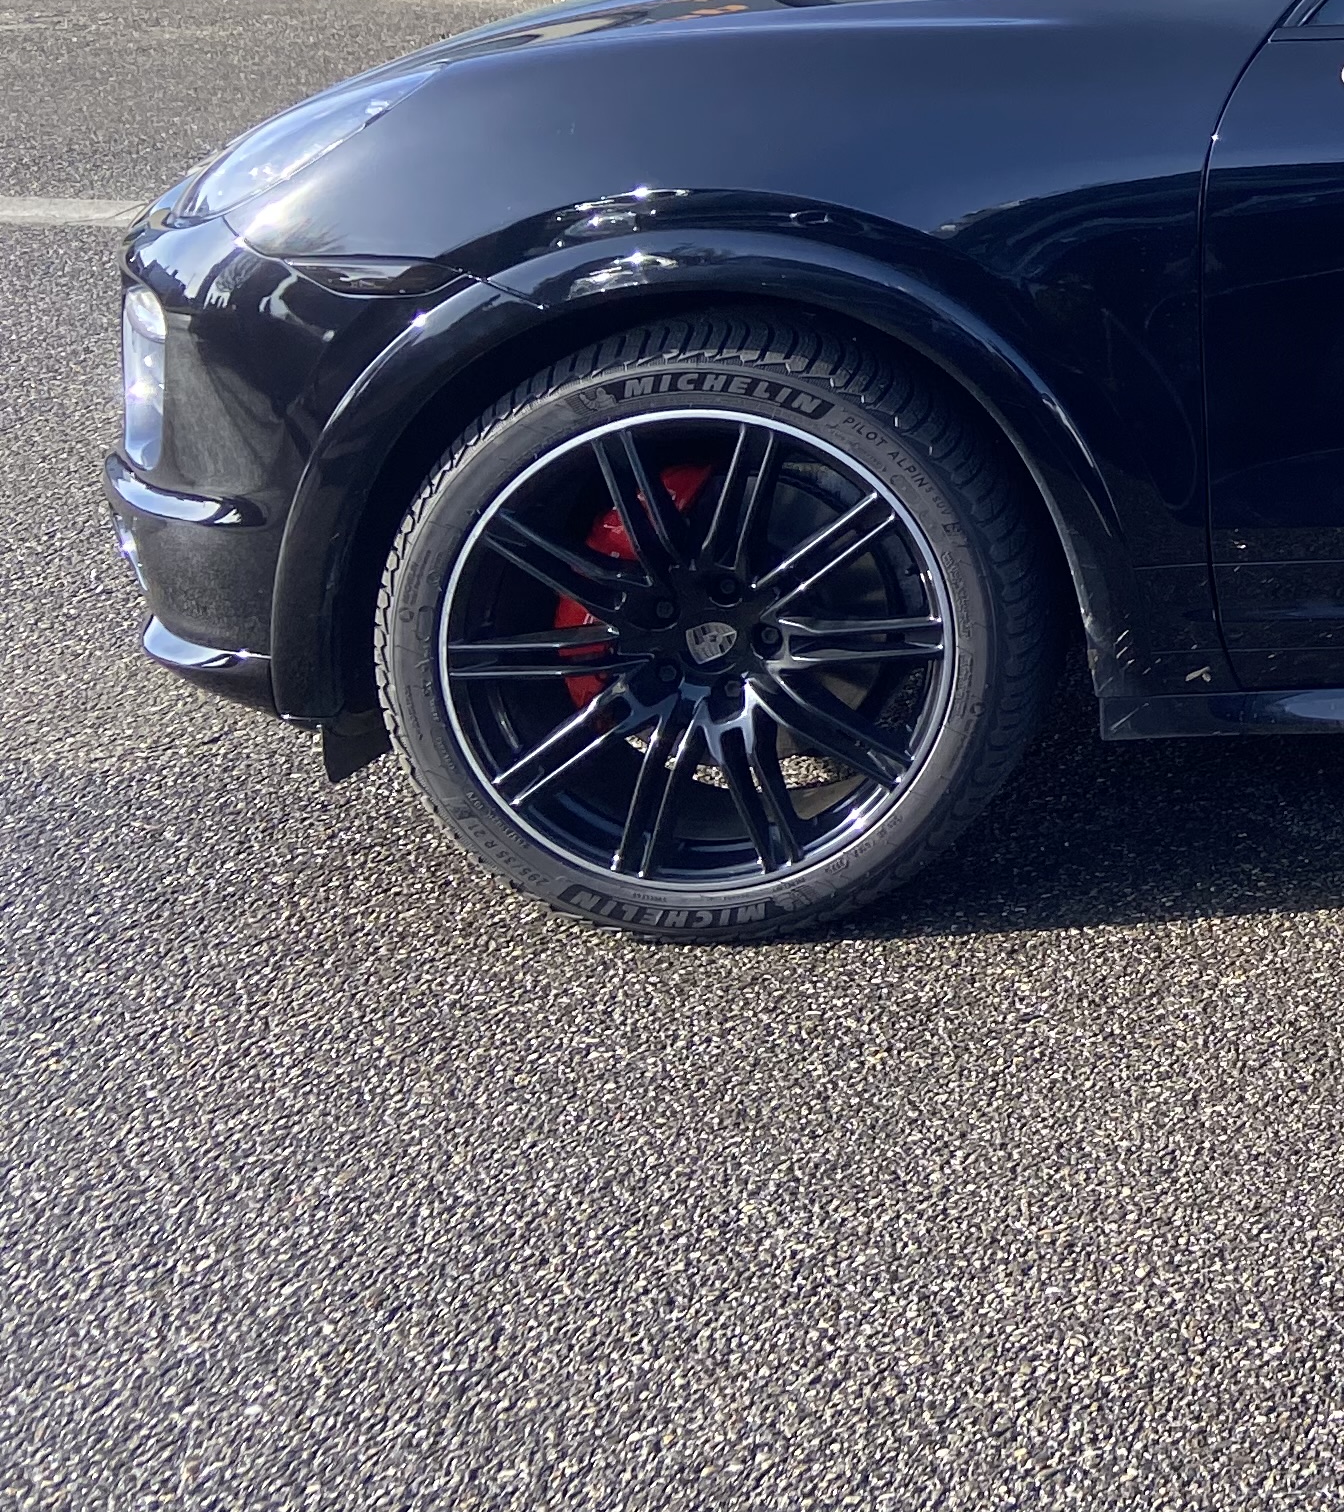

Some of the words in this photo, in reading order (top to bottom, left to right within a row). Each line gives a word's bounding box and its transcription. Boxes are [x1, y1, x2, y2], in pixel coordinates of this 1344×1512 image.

[623, 373, 823, 415] MICHELIN
[842, 416, 888, 447] PILOT
[484, 840, 498, 850] R
[496, 849, 550, 886] 295/35
[569, 890, 766, 929] MICHELIN
